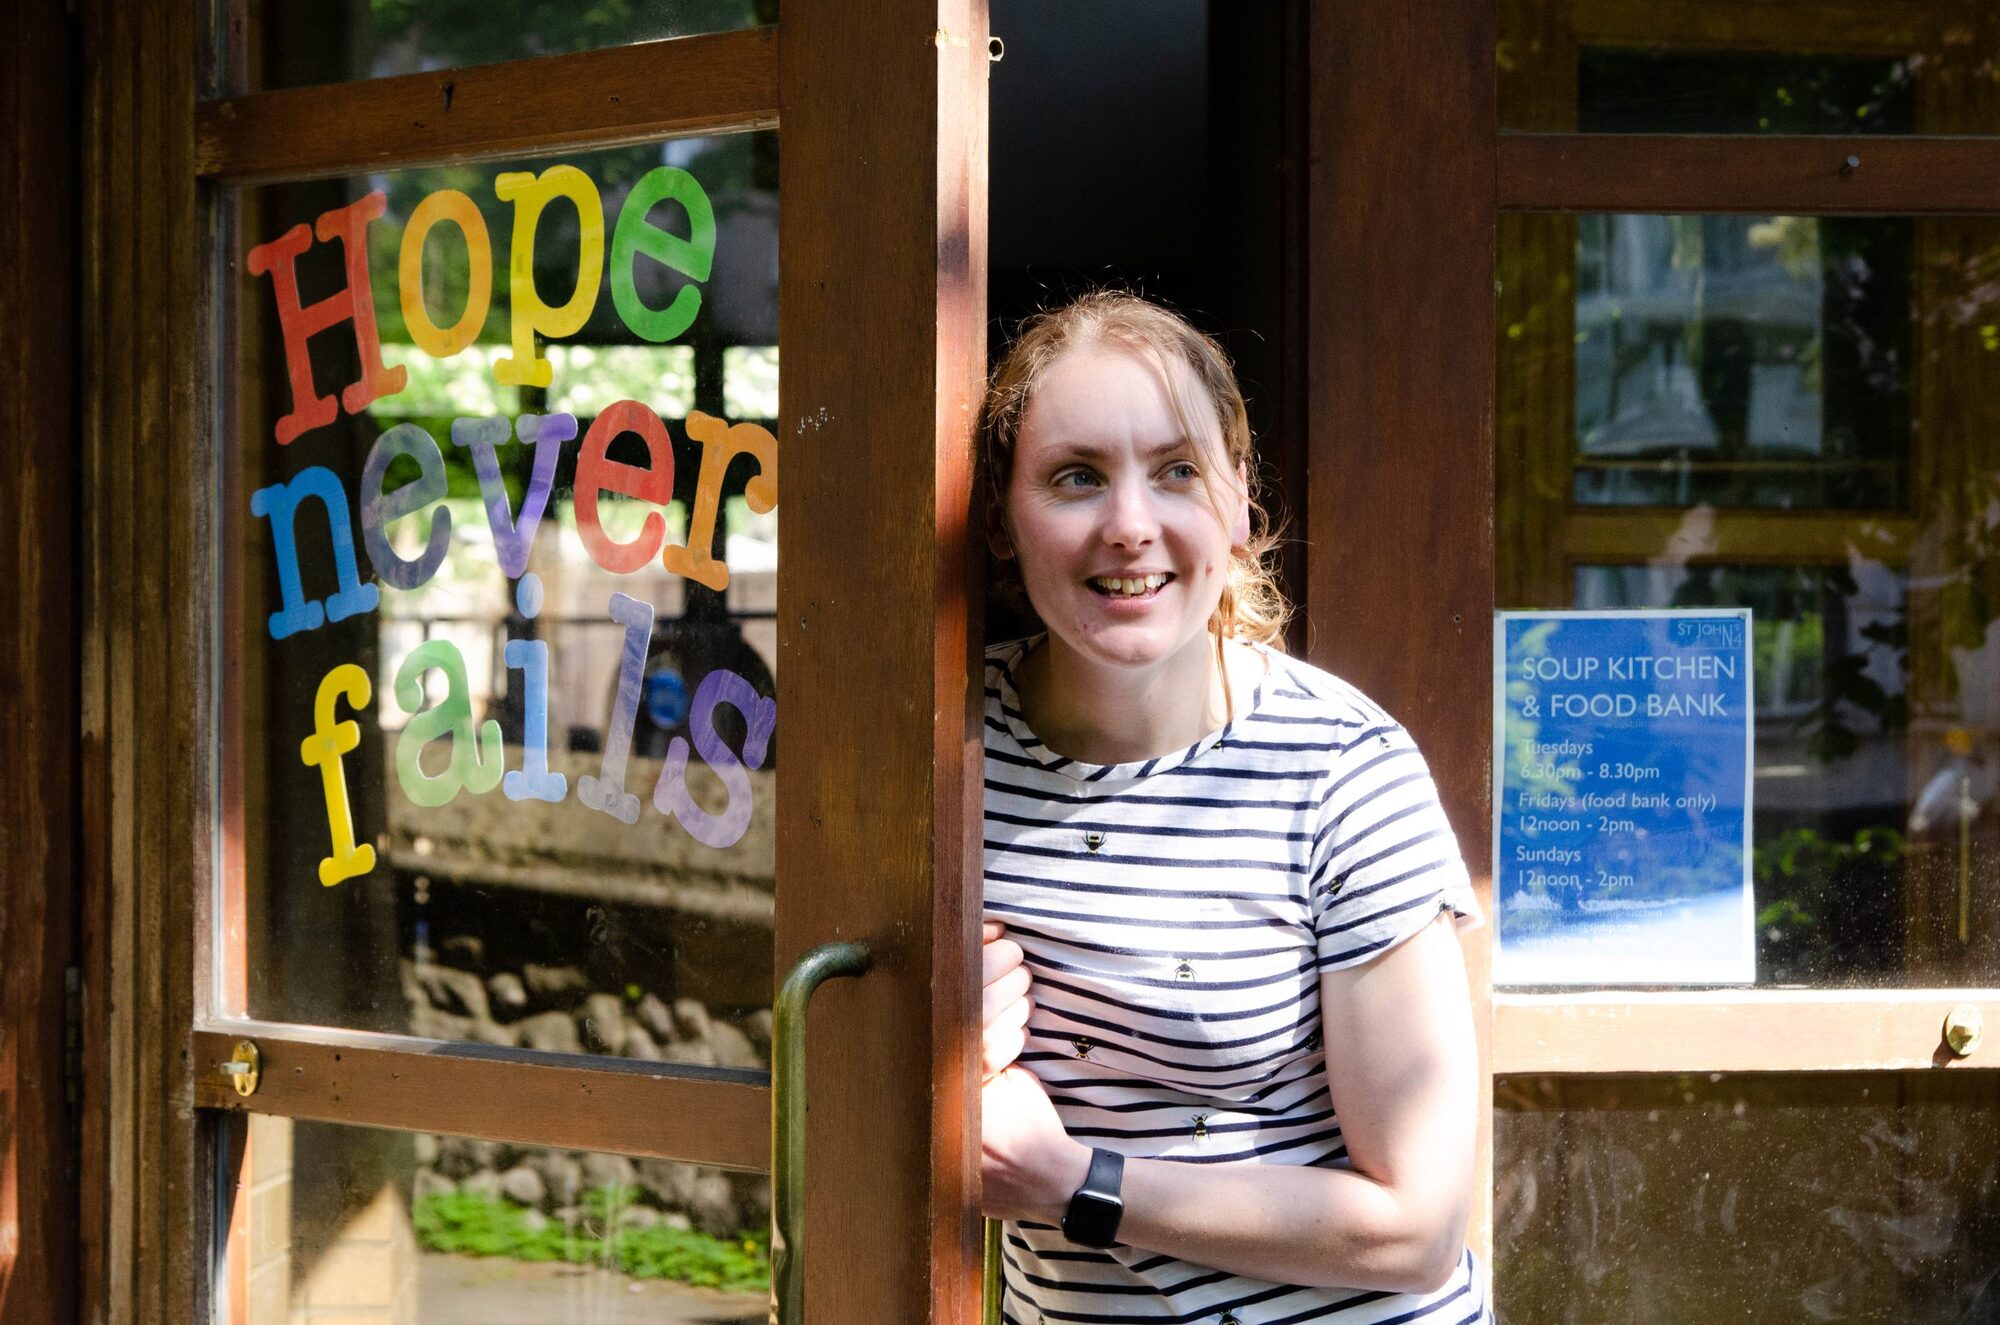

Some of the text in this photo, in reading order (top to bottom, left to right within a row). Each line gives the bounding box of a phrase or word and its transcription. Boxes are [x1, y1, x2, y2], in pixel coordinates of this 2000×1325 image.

[248, 164, 717, 444] Hope
[250, 400, 778, 640] never
[1522, 655, 1735, 680] SOUP KITCHEN
[1522, 693, 1728, 718] & FOOD BANK
[301, 573, 777, 887] fails
[1521, 739, 1594, 758] Tuesdays
[1520, 763, 1581, 782] 6.30pm
[1599, 762, 1660, 782] 8.30pm
[1519, 792, 1716, 812] Fridays (food bank only)
[1520, 815, 1580, 832] 12noon
[1599, 816, 1634, 836] 2pm
[1516, 845, 1581, 866] Sundays
[1518, 870, 1580, 887] 12noon
[1598, 870, 1634, 890] 2pm
